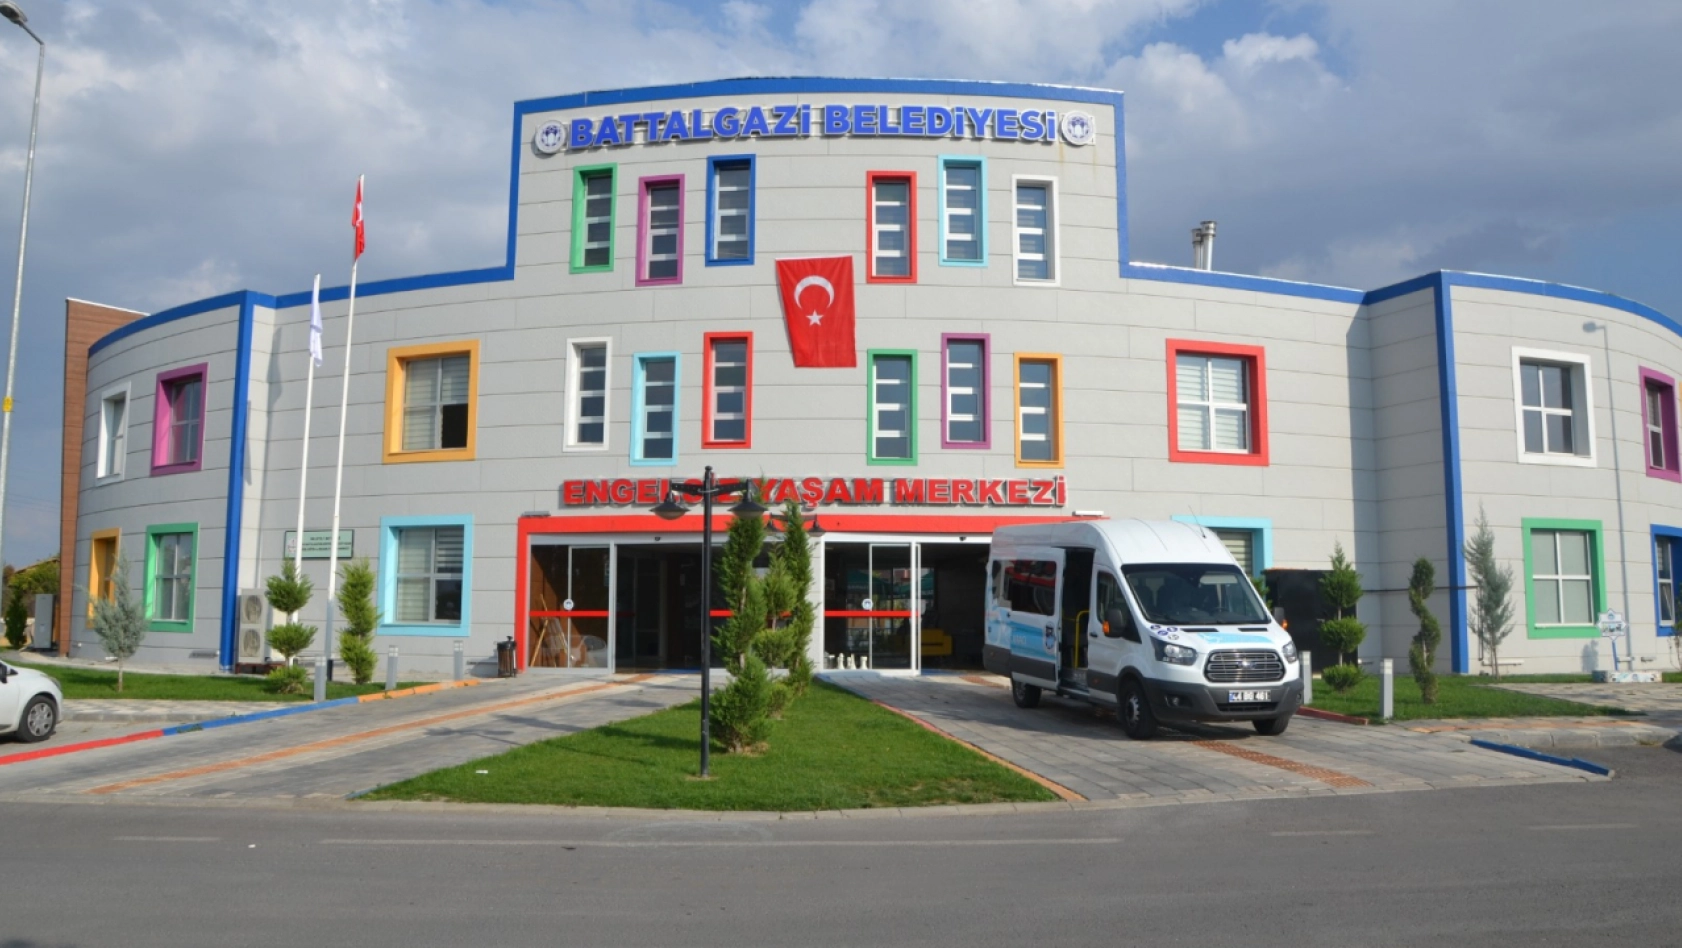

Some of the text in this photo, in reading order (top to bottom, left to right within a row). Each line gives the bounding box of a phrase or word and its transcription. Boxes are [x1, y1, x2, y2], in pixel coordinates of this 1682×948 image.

[563, 473, 1067, 508] ENGELSZ YAŞAM MERKEZİ
